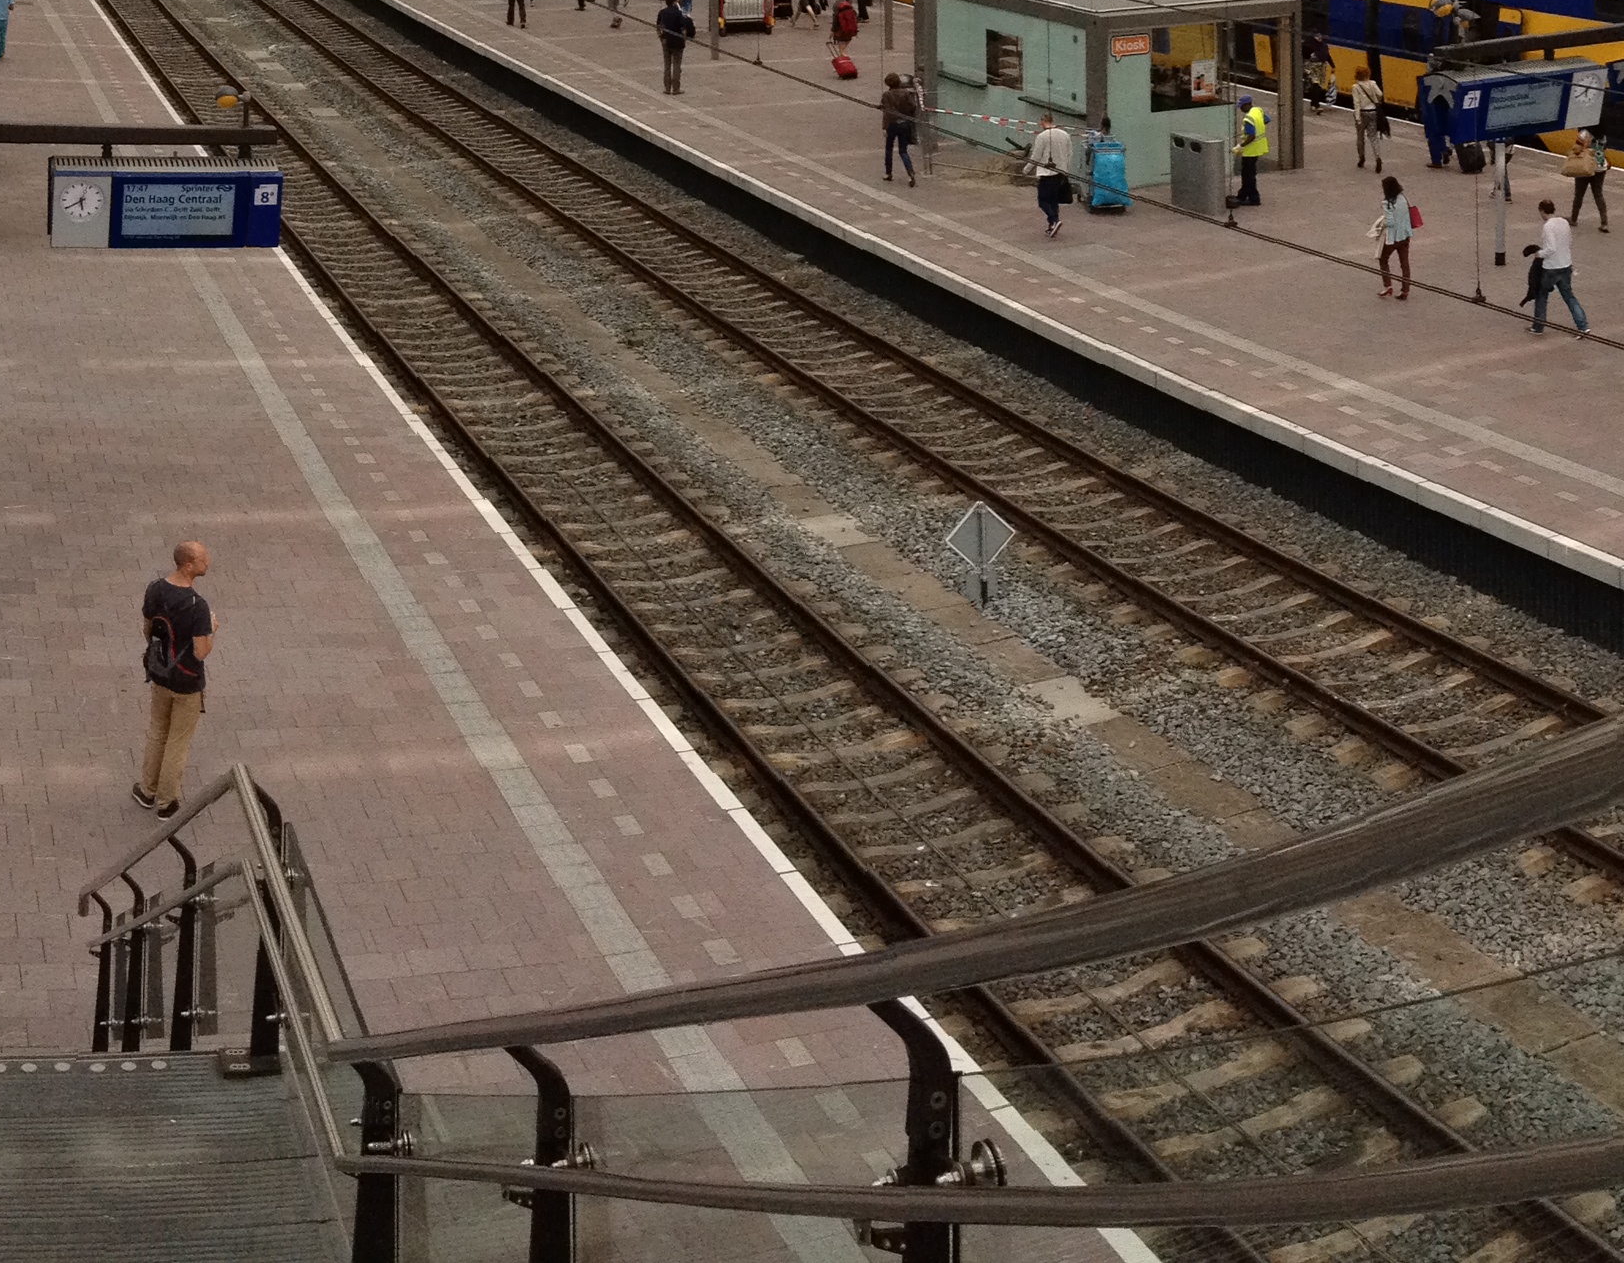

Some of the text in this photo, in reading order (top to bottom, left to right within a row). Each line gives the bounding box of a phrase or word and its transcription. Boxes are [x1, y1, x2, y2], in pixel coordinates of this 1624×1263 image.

[1115, 39, 1146, 52] Kiosk
[126, 185, 148, 193] 17:47
[181, 185, 215, 195] Sprinter
[124, 194, 222, 205] Den Haag Centraal
